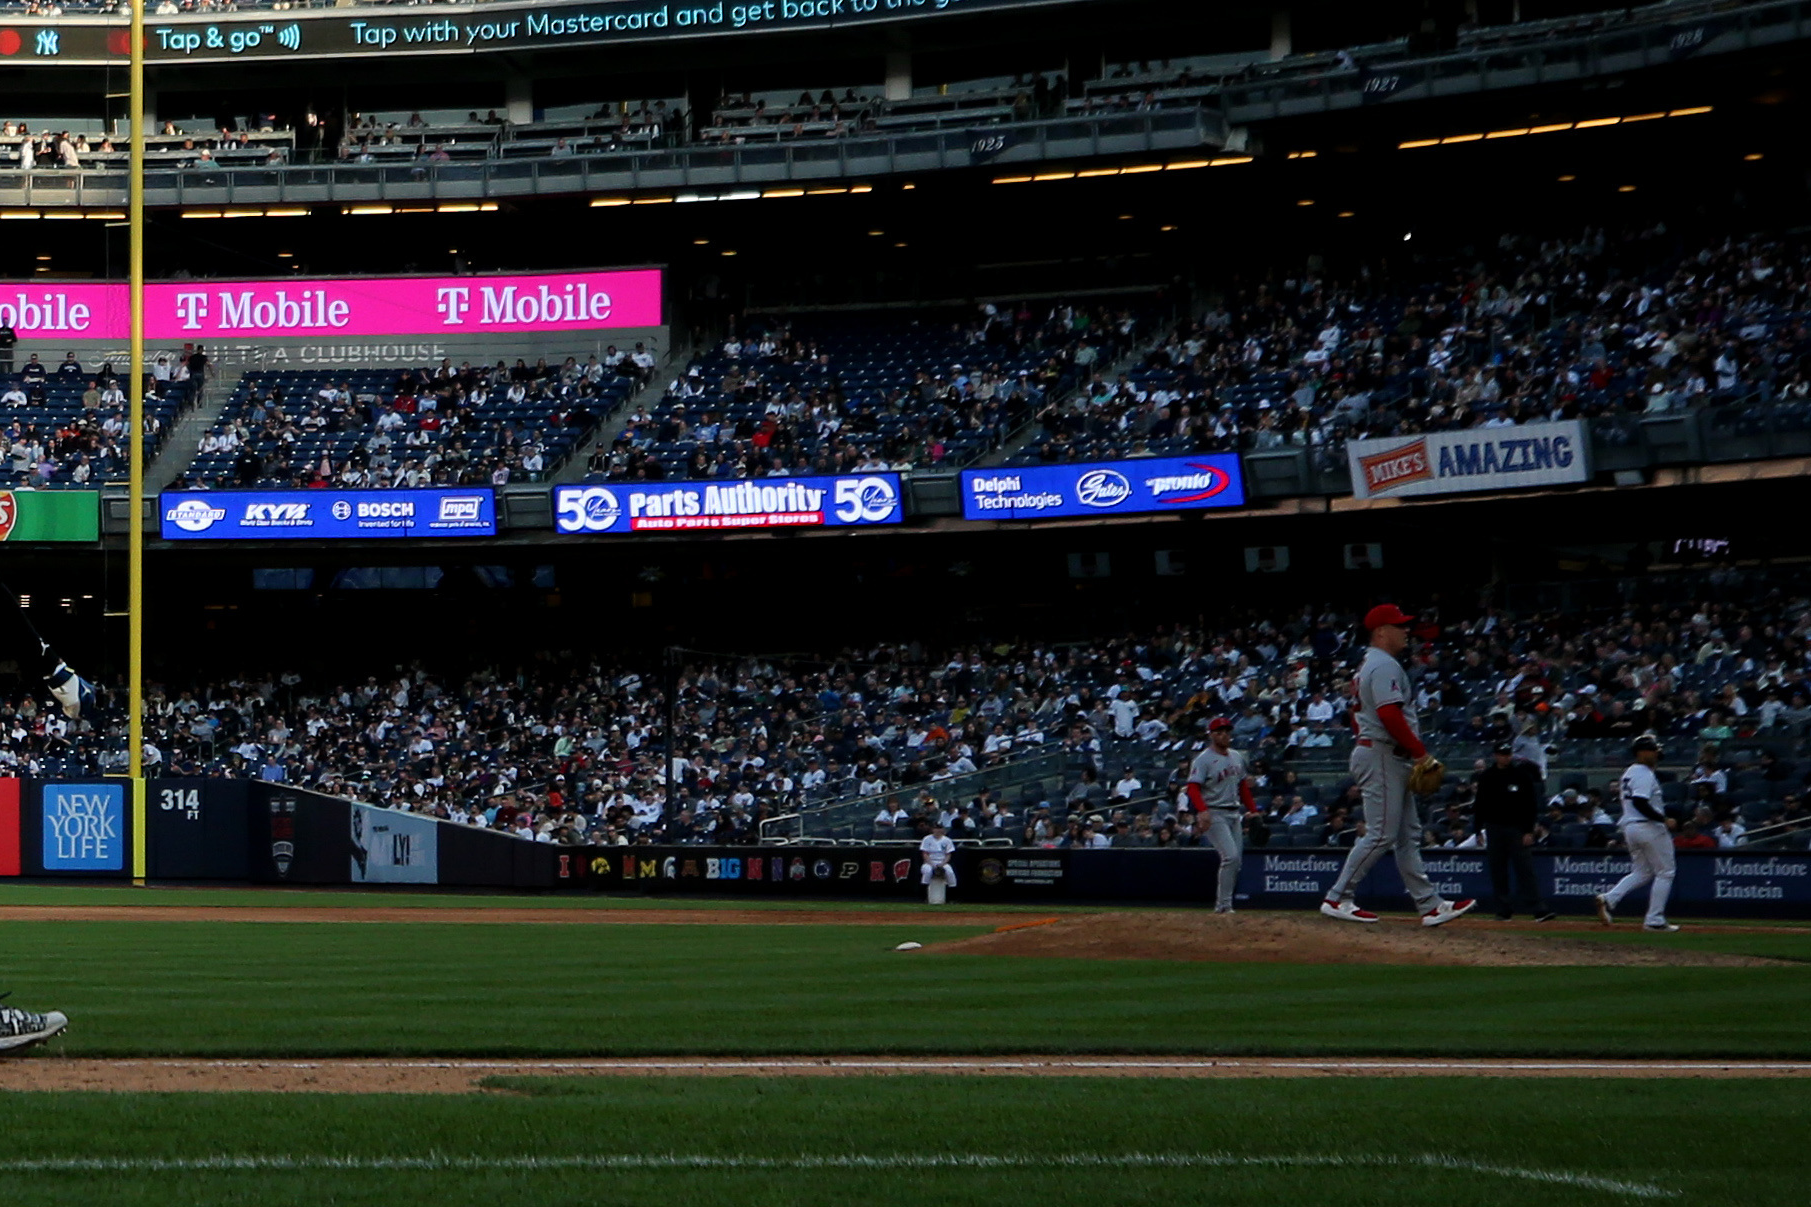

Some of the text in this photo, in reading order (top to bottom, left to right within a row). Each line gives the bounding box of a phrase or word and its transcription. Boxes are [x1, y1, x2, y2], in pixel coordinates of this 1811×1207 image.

[351, 23, 396, 49] Tap
[405, 19, 460, 44] with
[466, 15, 520, 45] your
[528, 4, 669, 37] Mastercard
[676, 0, 724, 27] and
[157, 29, 200, 53] Tap
[207, 28, 225, 48] &
[1364, 75, 1401, 93] 1927
[218, 290, 351, 329] Mobile
[479, 284, 612, 324] Mobile
[300, 343, 446, 364] CLUBHOUSE
[1370, 436, 1574, 484] MIKE'S AMAZING
[973, 475, 1022, 493] Delphi
[1084, 474, 1129, 501] Gates
[1151, 472, 1212, 496] pronto
[357, 502, 414, 517] BOSCH
[558, 487, 619, 531] 50
[630, 481, 822, 518] Parts Authority
[835, 477, 895, 523] 50
[975, 491, 1063, 510] Technologies
[169, 509, 222, 520] STANDARD
[245, 503, 307, 520] KYB
[445, 504, 474, 517] mpa
[358, 520, 389, 528] Invented
[391, 520, 402, 528] for
[637, 514, 819, 528] Auto Parts Super Stores
[57, 794, 111, 817] NEW
[160, 789, 200, 811] 314
[187, 810, 200, 820] FT
[47, 814, 116, 841] YORK
[57, 837, 109, 859] LIFE
[1264, 855, 1339, 872] Montefiore
[1554, 855, 1633, 874] Montefior
[1714, 857, 1807, 876] Montefiore
[1265, 875, 1319, 892] Einstein
[1715, 880, 1784, 899] Einstein
